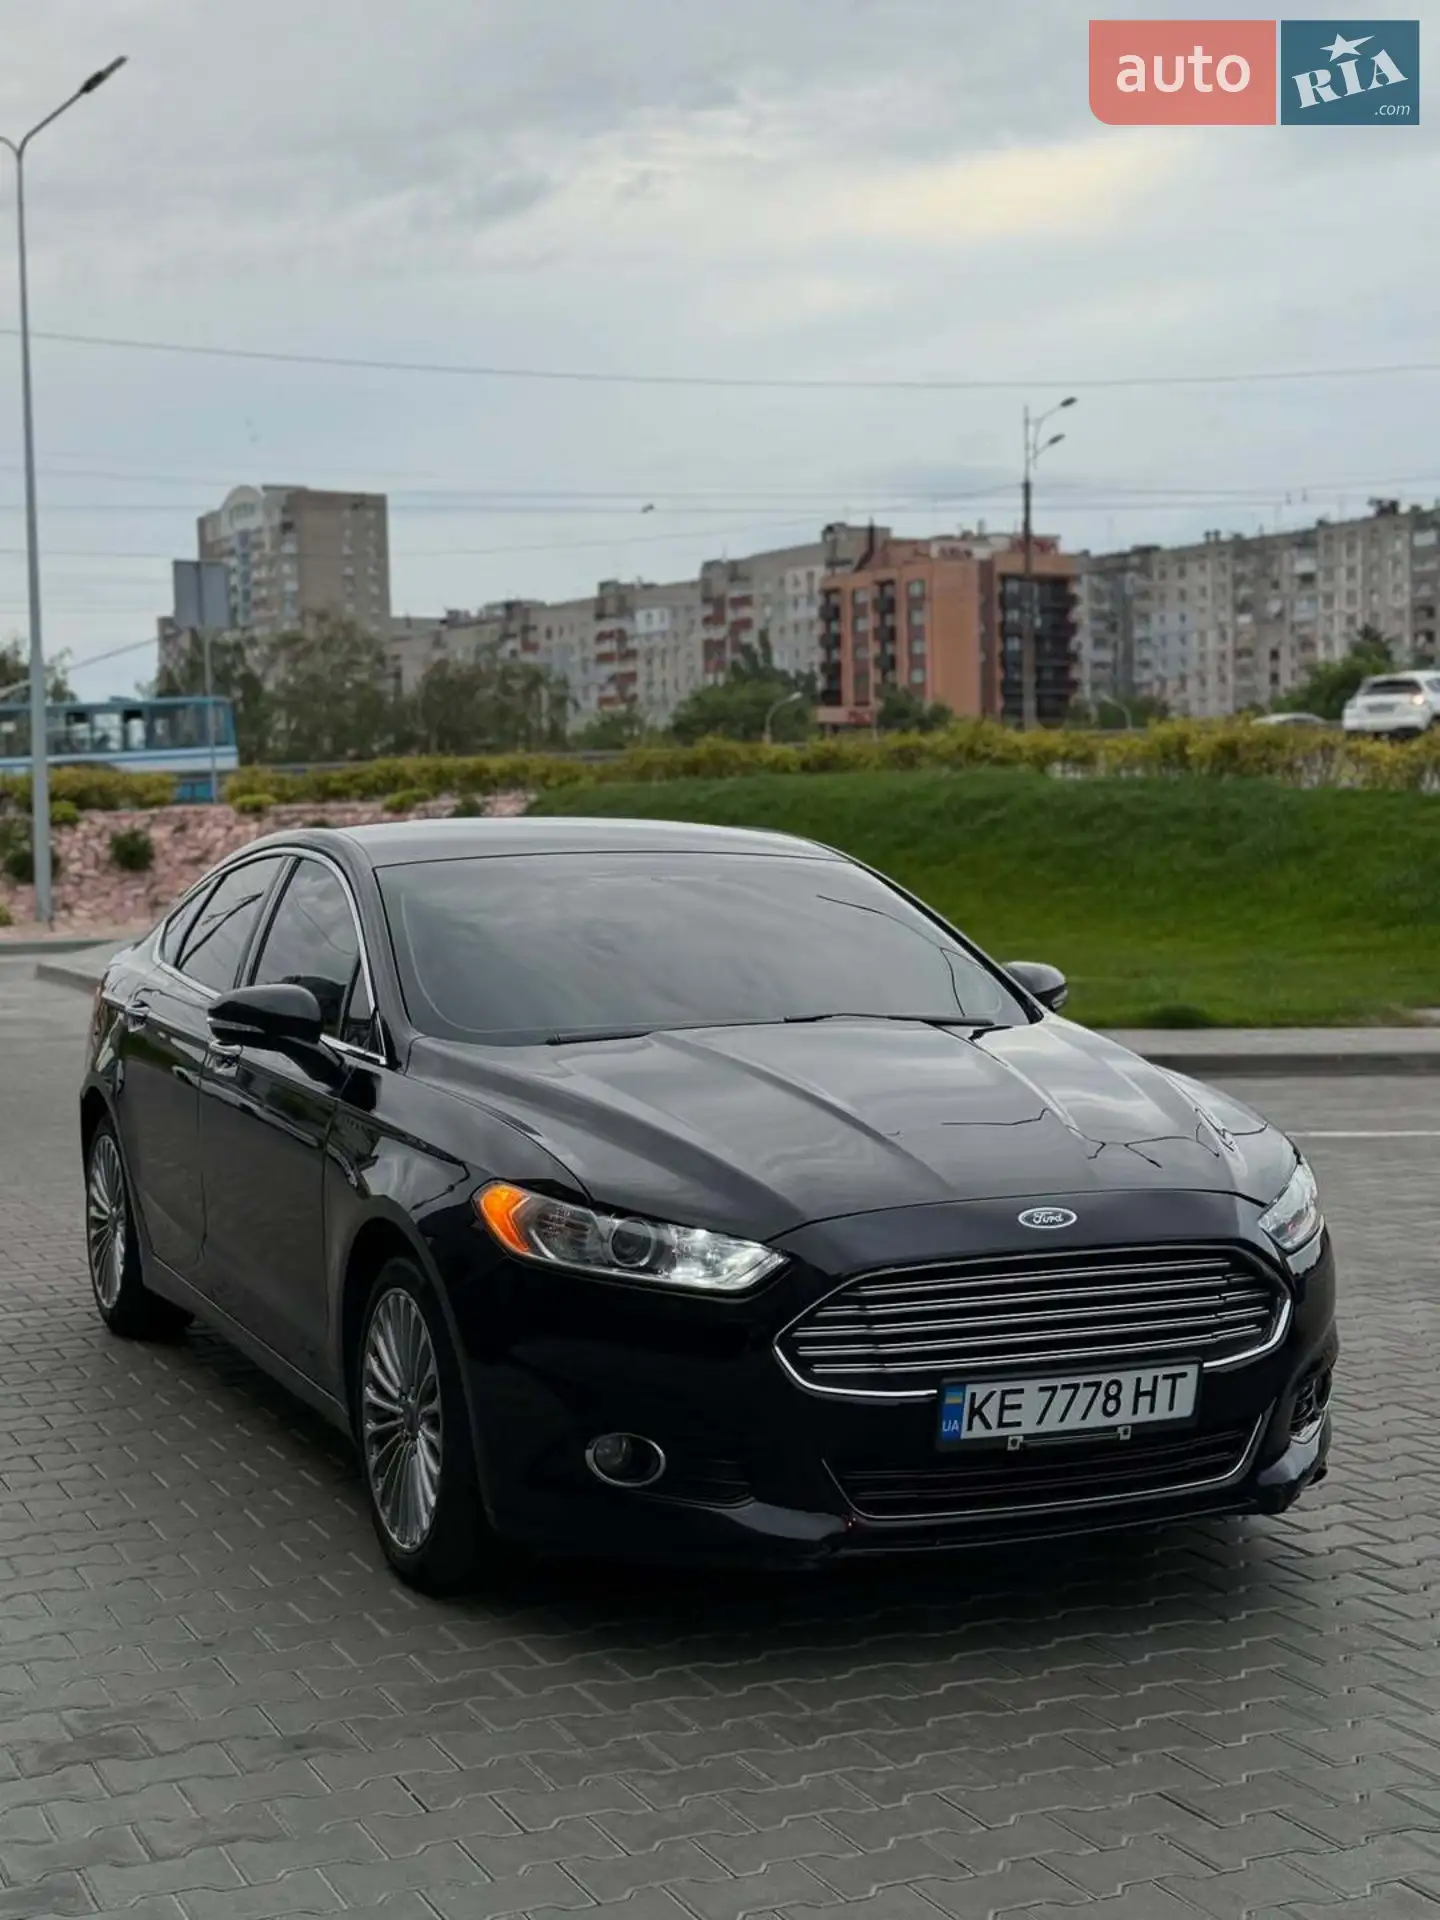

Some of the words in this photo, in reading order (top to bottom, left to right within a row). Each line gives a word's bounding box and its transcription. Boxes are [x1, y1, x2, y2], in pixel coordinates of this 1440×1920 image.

[1032, 1211, 1065, 1224] Ford
[966, 1388, 1025, 1431] KE
[1036, 1379, 1122, 1425] 7778
[1131, 1372, 1188, 1415] HT
[942, 1420, 959, 1432] UA
